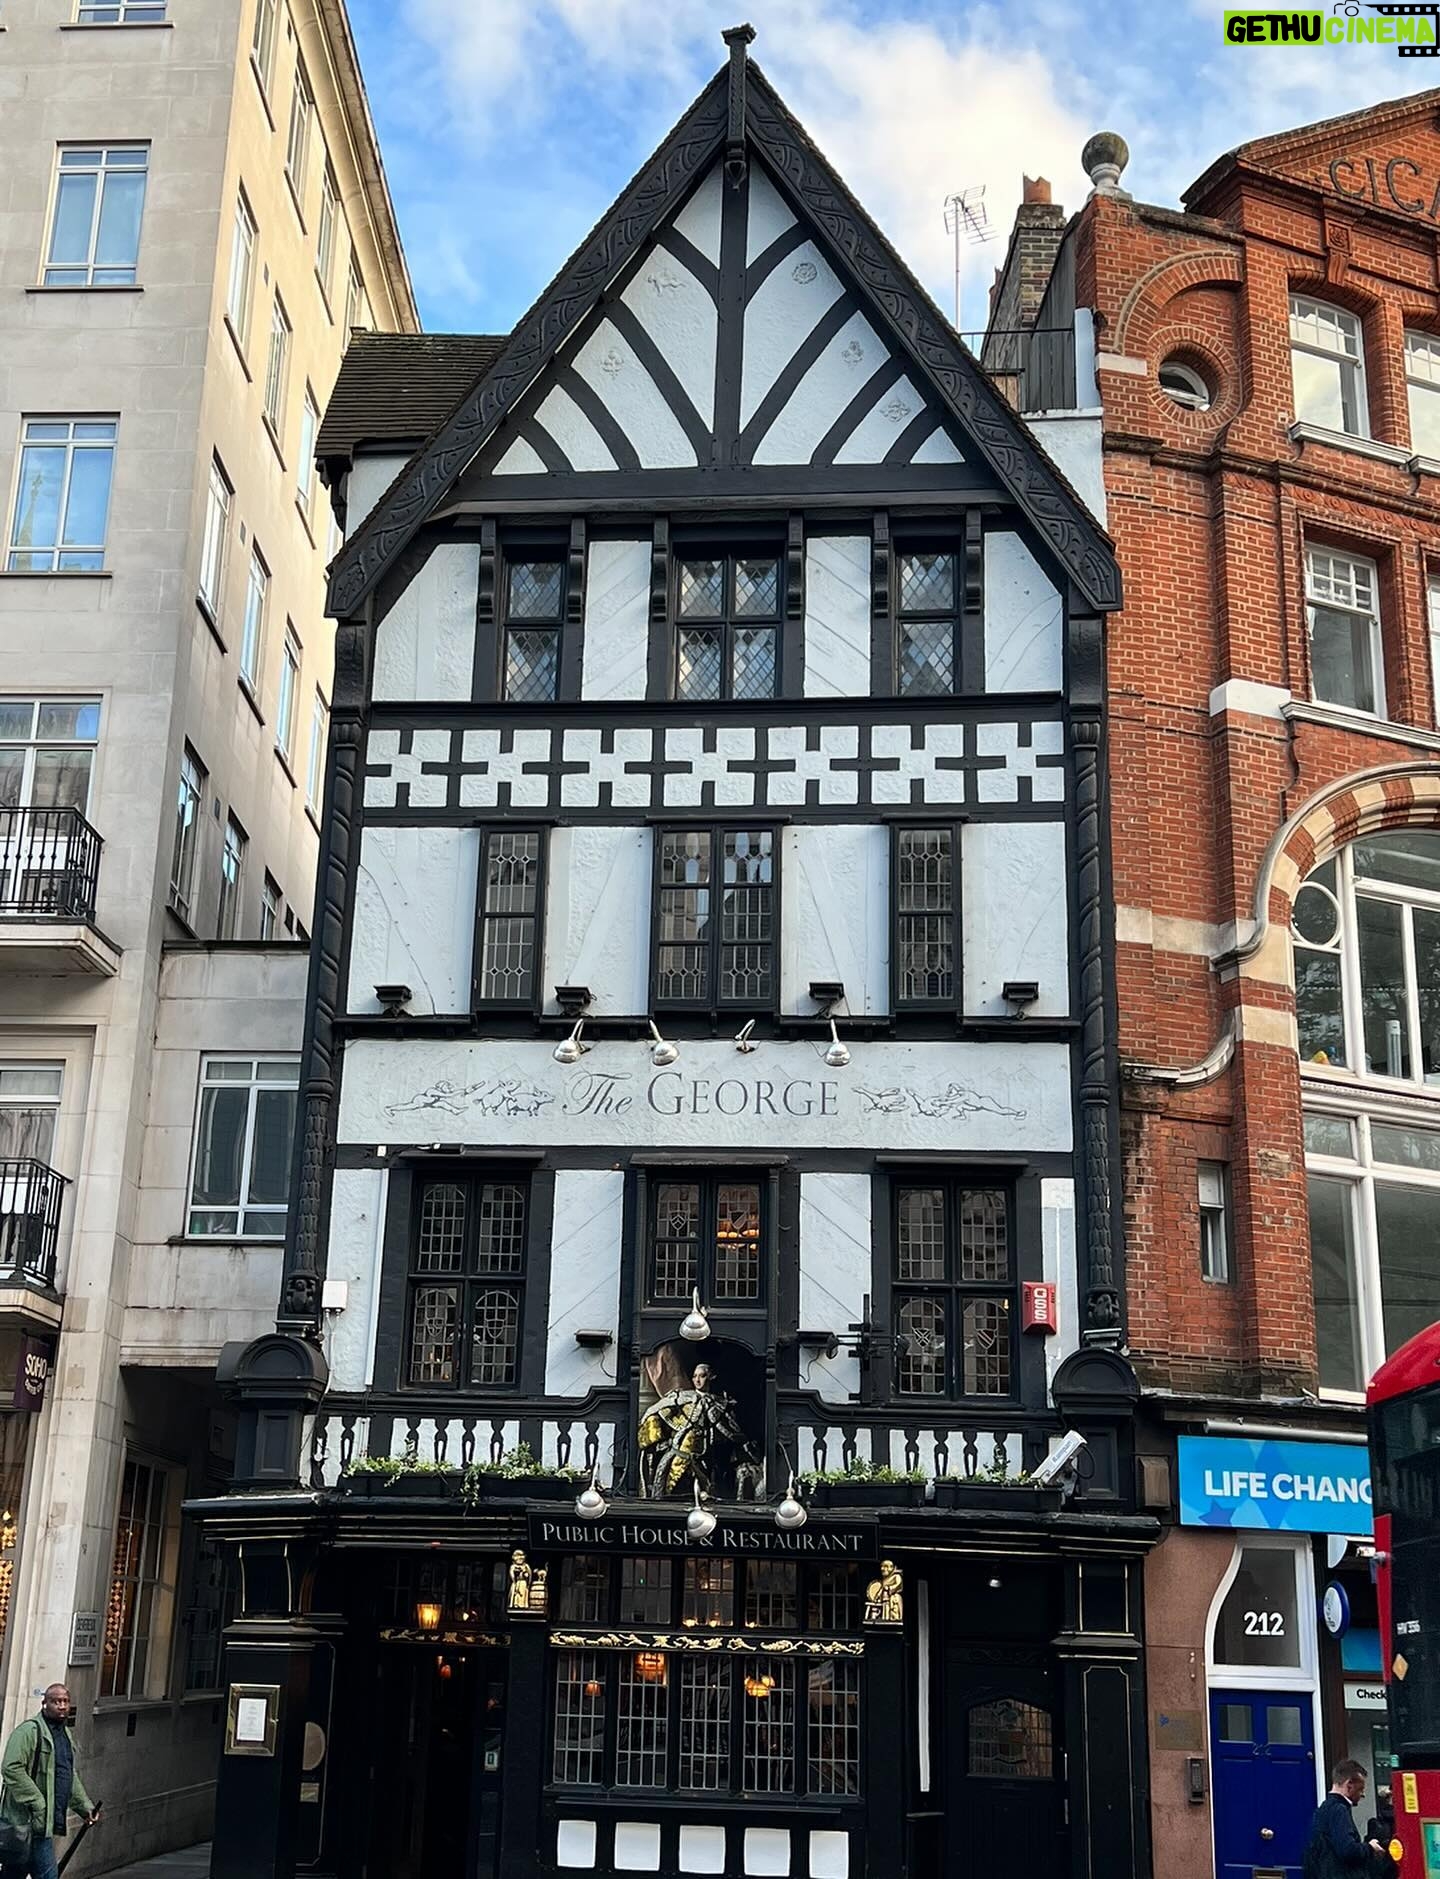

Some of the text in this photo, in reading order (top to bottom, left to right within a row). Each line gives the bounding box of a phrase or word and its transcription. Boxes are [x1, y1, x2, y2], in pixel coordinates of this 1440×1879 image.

[562, 1070, 839, 1116] The GEORGE
[1204, 1470, 1268, 1498] LIFE
[542, 1522, 614, 1544] PUBLIC
[722, 1528, 863, 1551] RESTAURANT
[1244, 1612, 1285, 1636] 212
